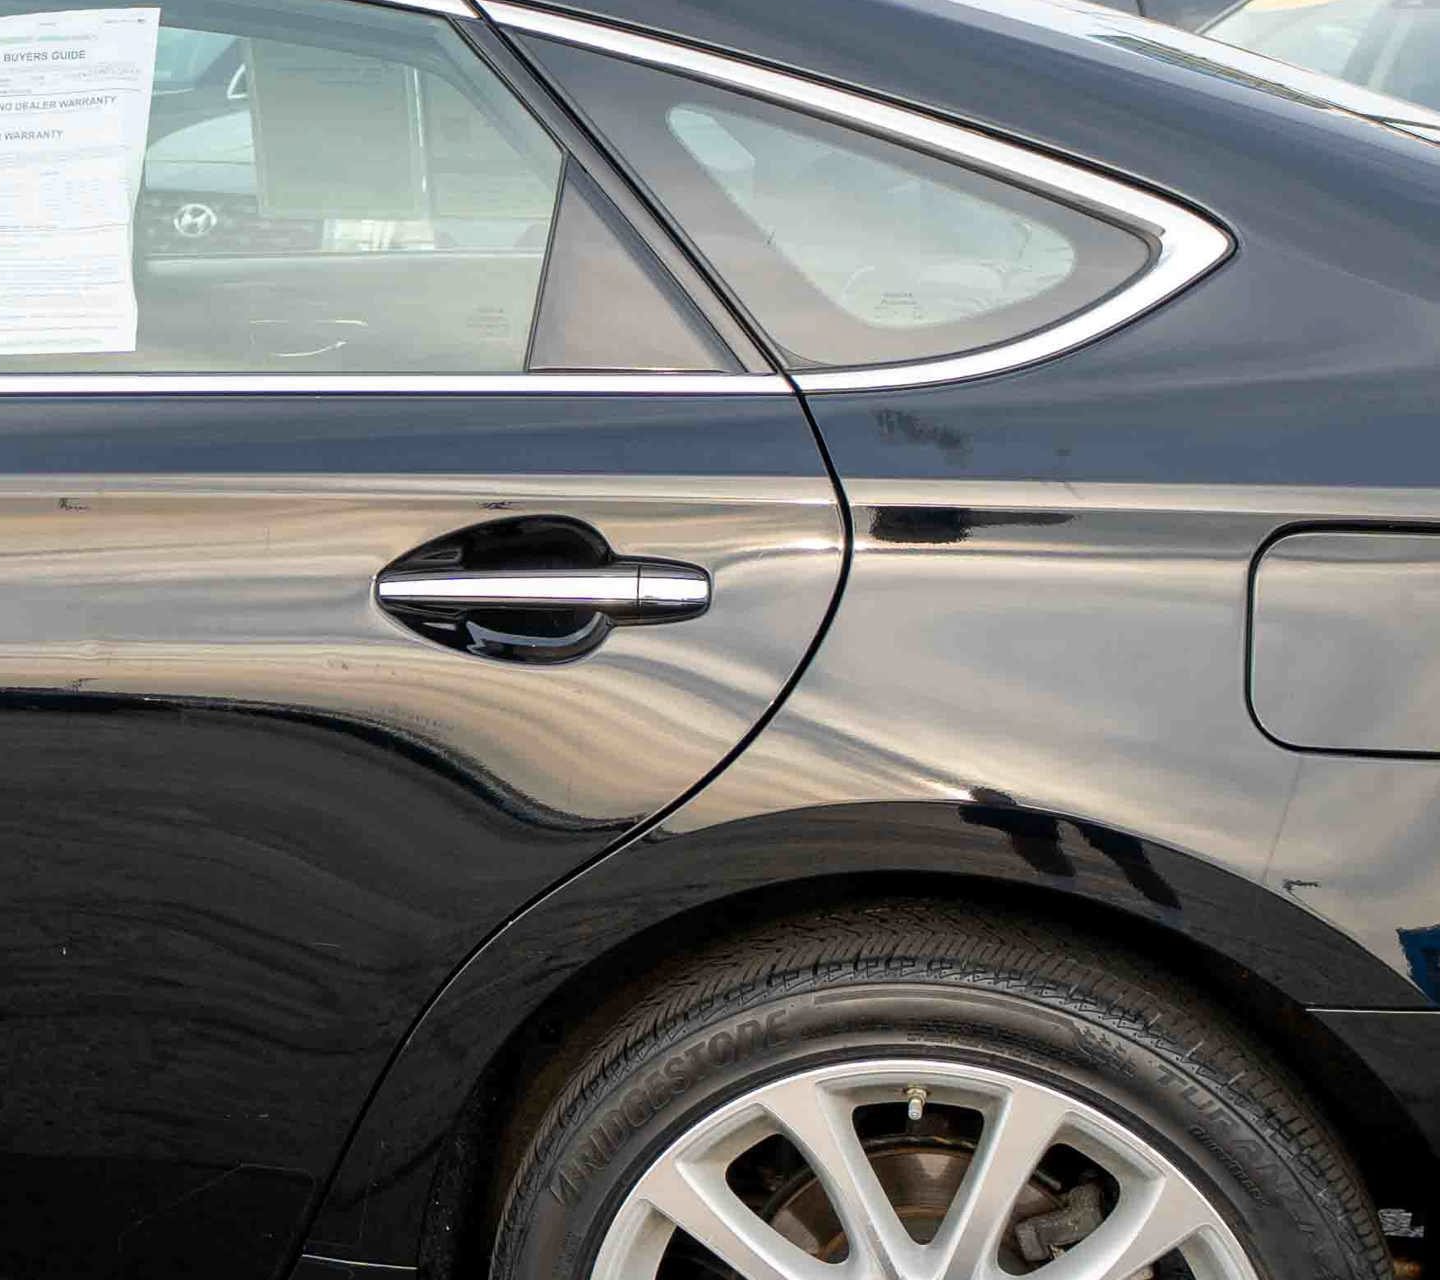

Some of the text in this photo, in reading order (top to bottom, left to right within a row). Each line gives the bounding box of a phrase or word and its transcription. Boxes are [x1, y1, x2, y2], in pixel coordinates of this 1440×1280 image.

[2, 49, 87, 63] BUYERS GUIDE
[14, 98, 58, 111] DEALER
[58, 95, 117, 110] WARRANTY
[4, 129, 64, 142] WARRANTY
